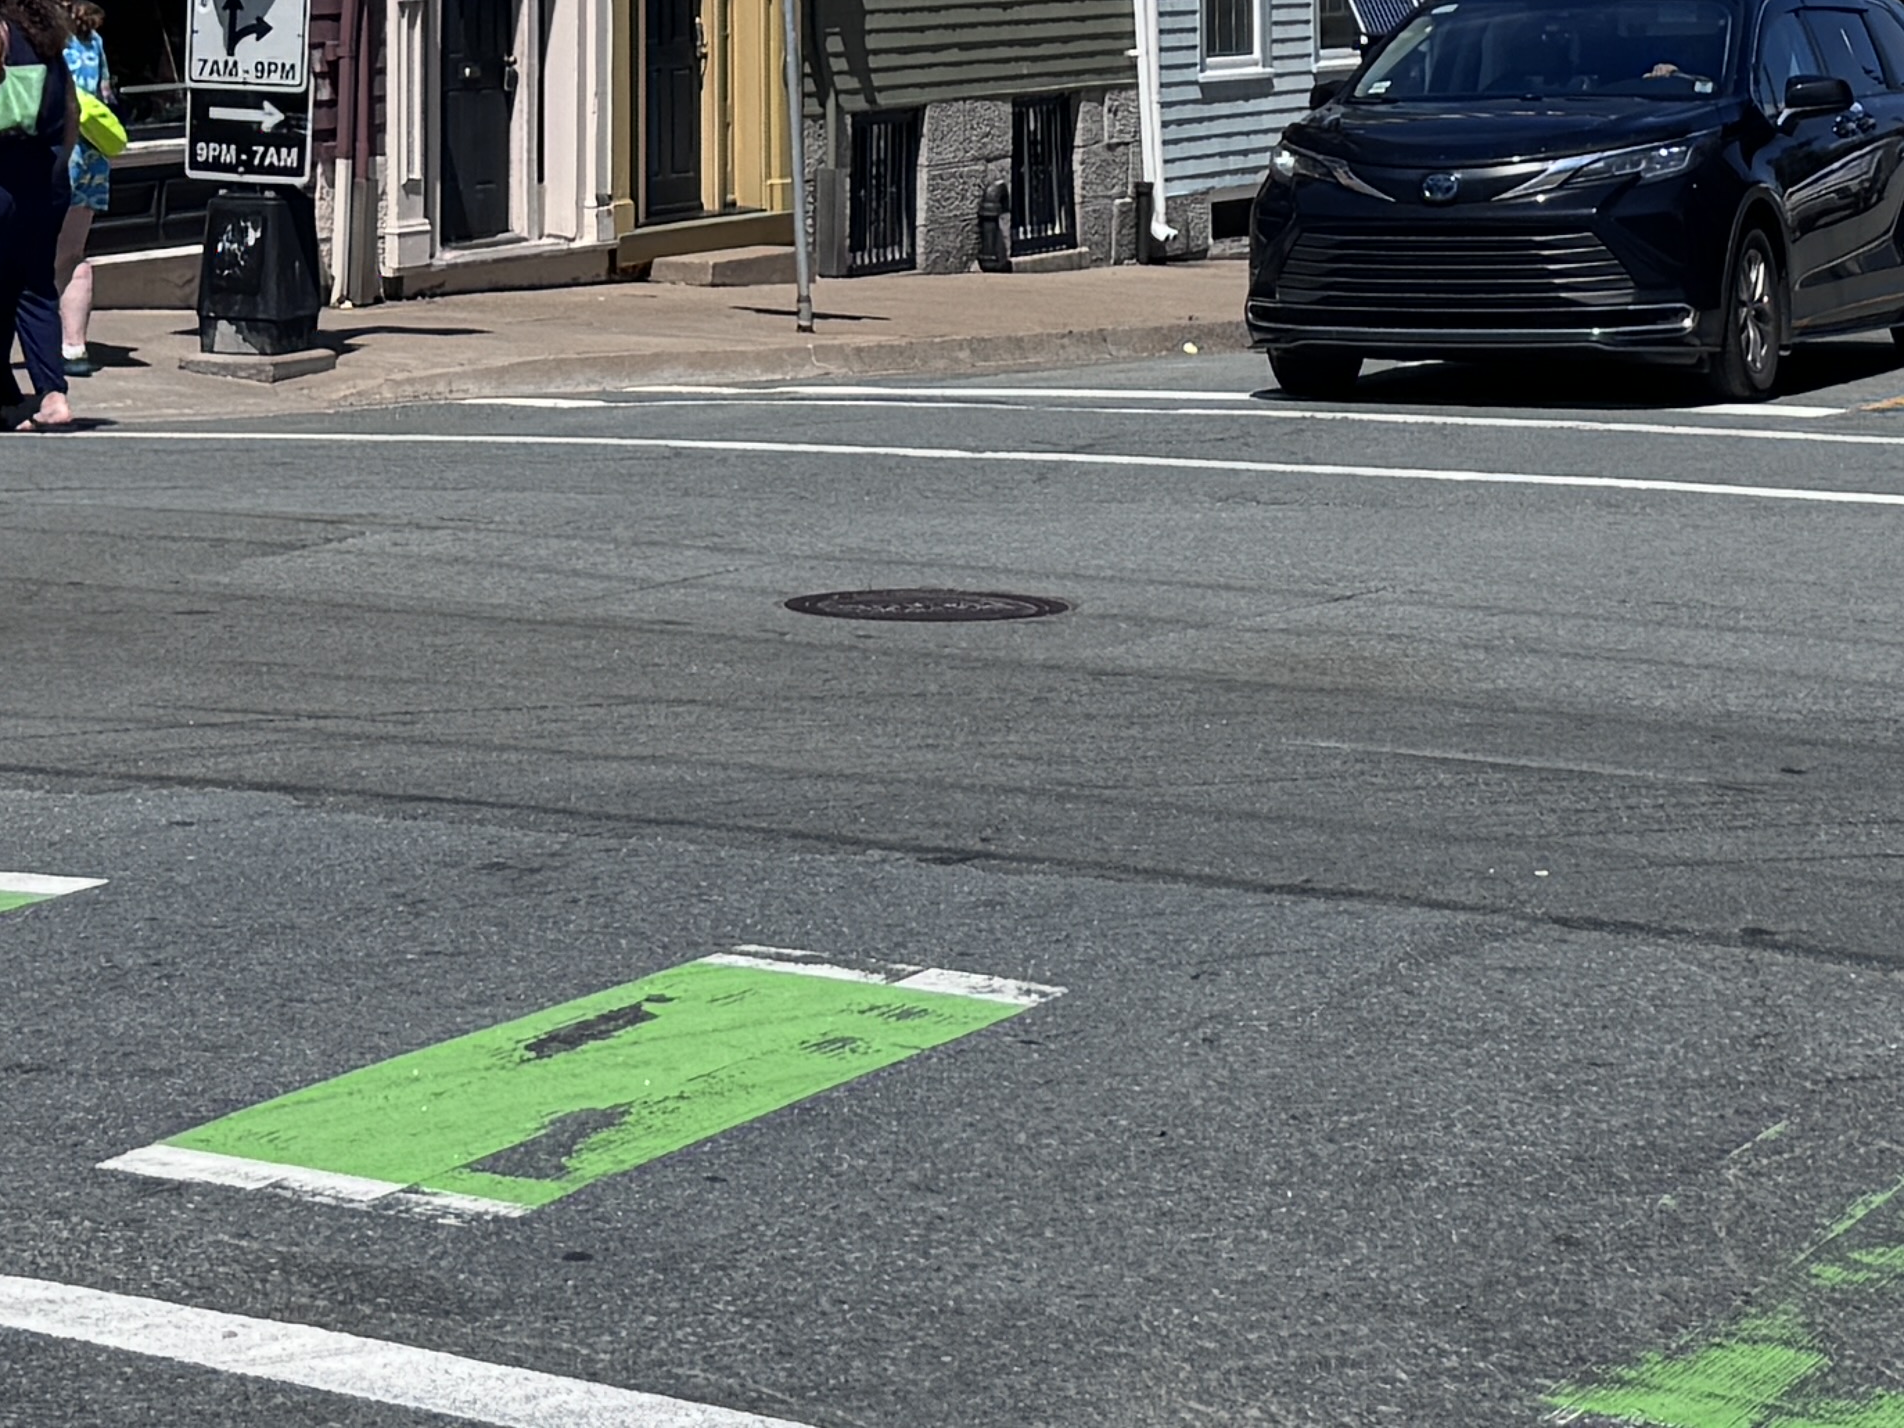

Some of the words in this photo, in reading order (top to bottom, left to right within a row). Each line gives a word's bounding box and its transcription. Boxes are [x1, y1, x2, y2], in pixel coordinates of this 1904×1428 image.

[198, 58, 239, 78] 7AM
[254, 61, 296, 81] 9PM
[195, 142, 237, 165] 9PM
[252, 146, 298, 169] 7AM
